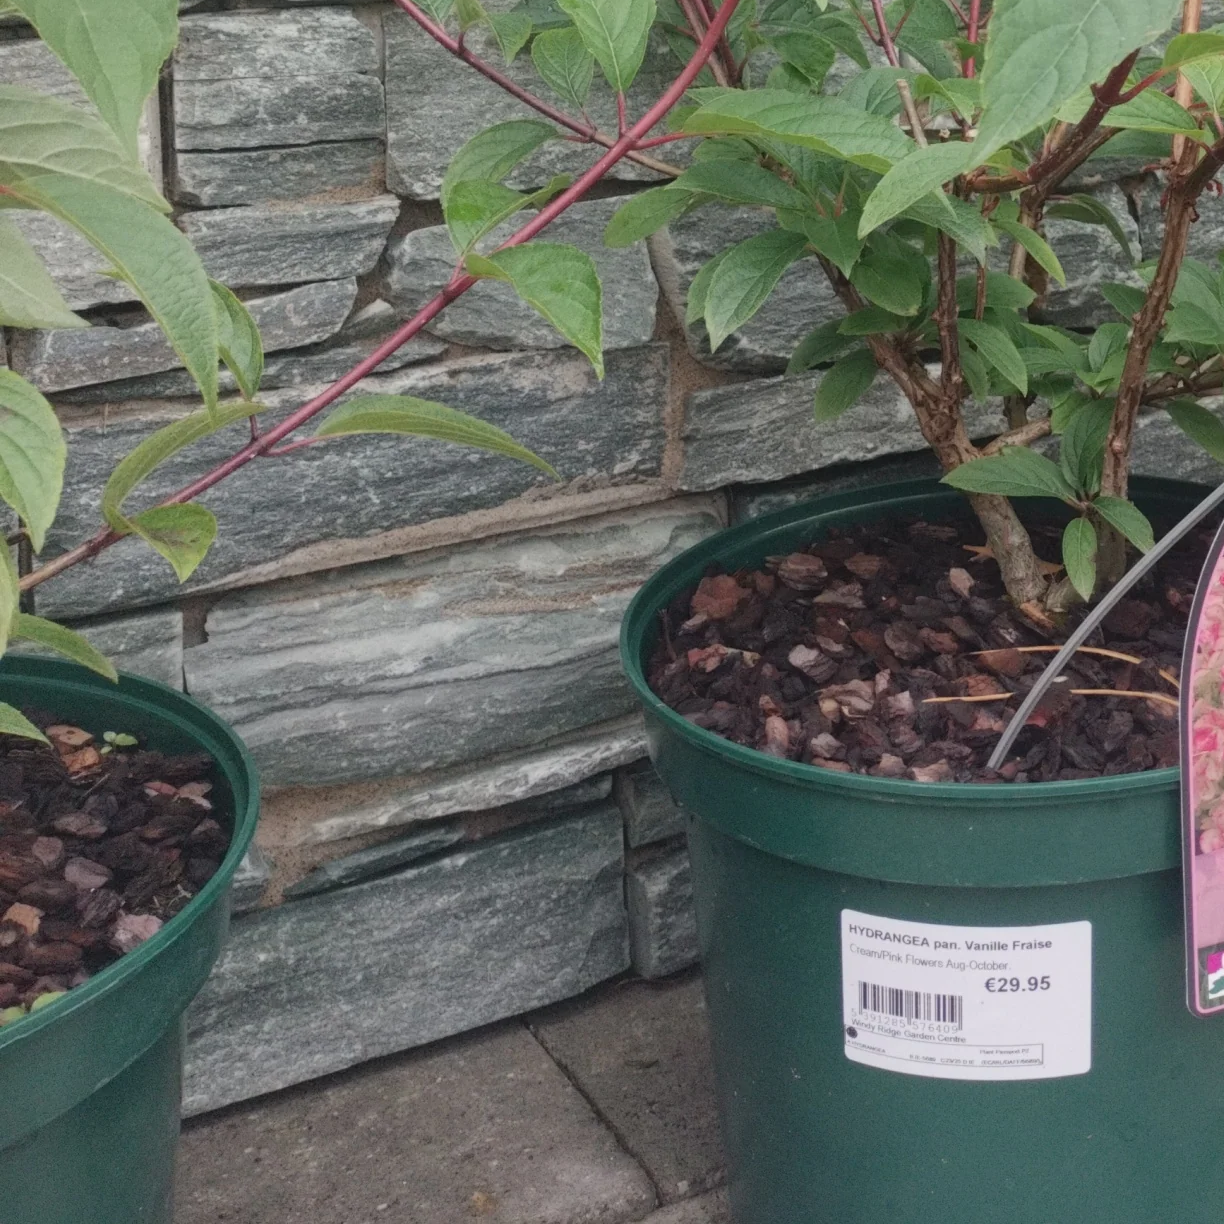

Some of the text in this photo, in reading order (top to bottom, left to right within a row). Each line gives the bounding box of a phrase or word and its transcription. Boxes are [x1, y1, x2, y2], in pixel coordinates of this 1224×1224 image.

[848, 923, 1053, 951] HYDRANGEA pan. Vanille Fraise
[849, 942, 904, 964] Cream/Pink
[905, 955, 944, 969] Flowers
[984, 975, 1051, 993] €29.95
[851, 1017, 967, 1044] Windy Ridge Garden Centre
[862, 1011, 906, 1028] 391285
[912, 1021, 959, 1034] 576409
